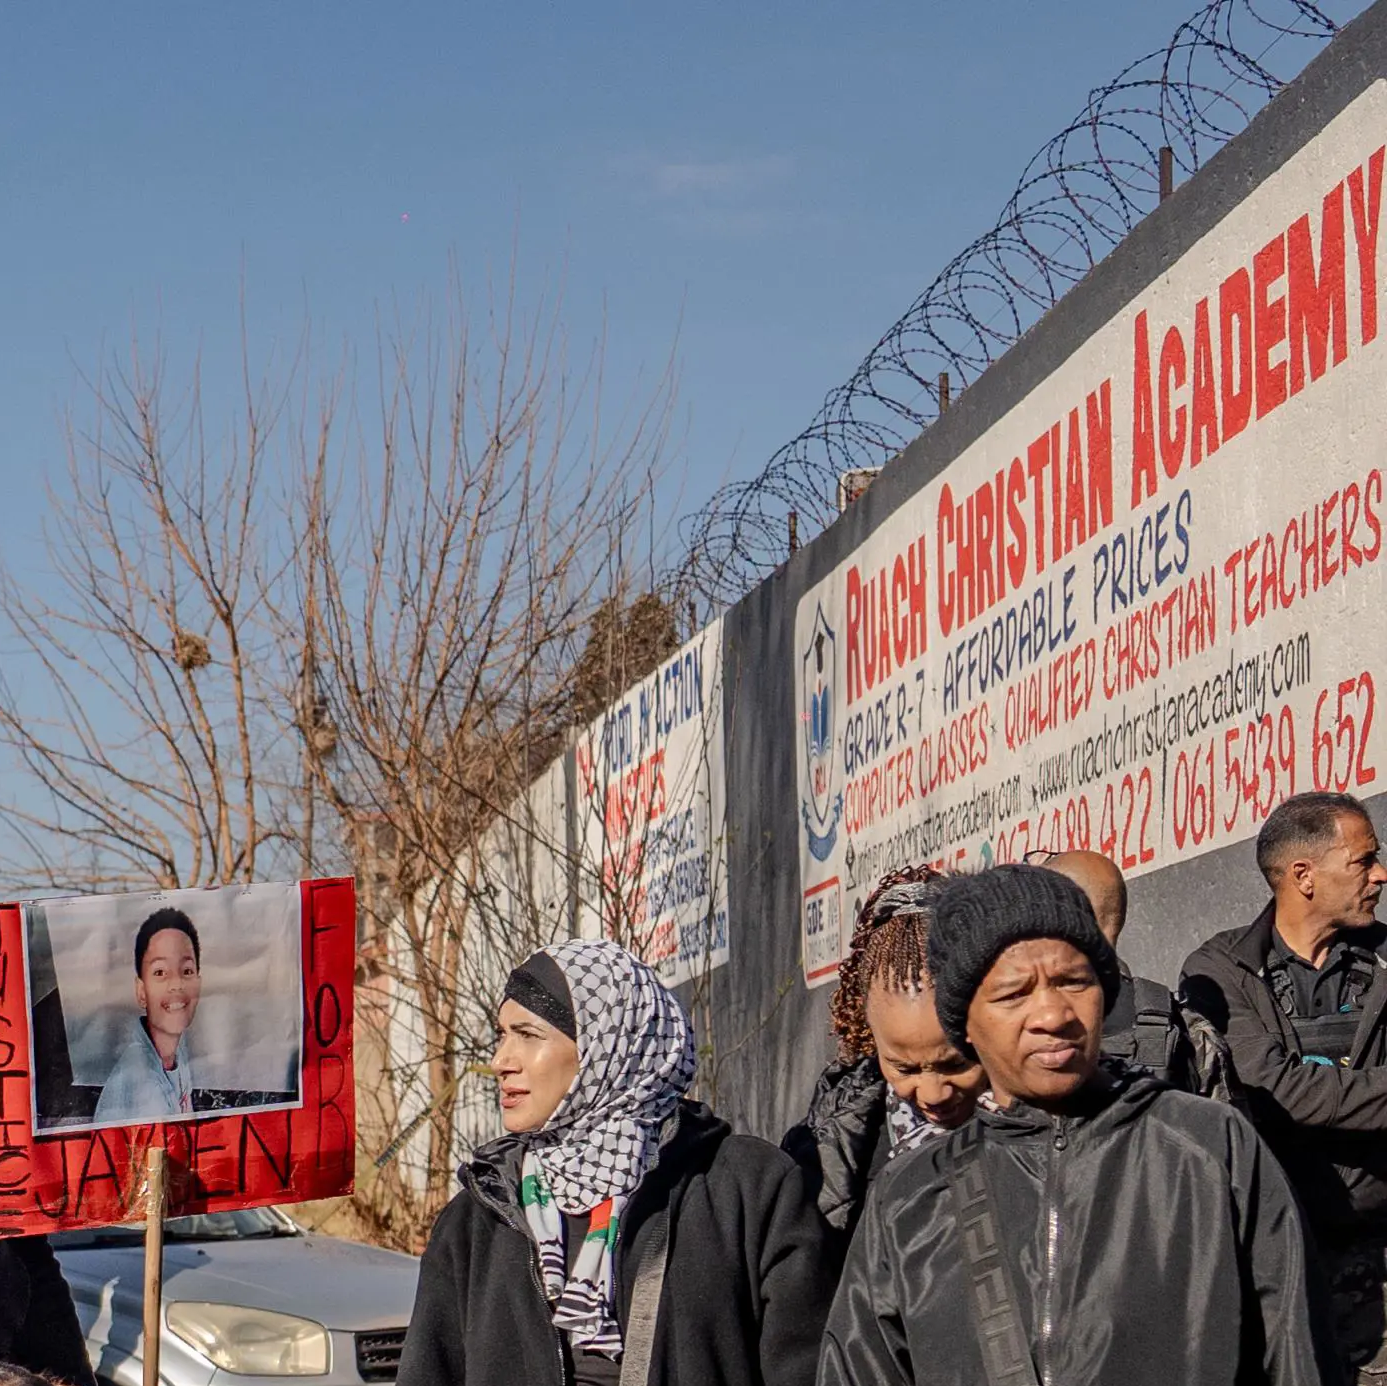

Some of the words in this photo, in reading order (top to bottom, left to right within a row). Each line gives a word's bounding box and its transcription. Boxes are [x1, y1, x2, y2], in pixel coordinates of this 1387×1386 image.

[846, 535, 928, 706] RUACH
[937, 378, 1114, 639] CHRISTIAN
[1130, 144, 1386, 511] ACADEMY
[844, 692, 894, 779] GRADE
[944, 566, 1077, 716] AFFORDABLE
[1093, 488, 1192, 625] PRICES
[844, 747, 914, 834] COMPUTER
[919, 701, 989, 798] CLASSES
[1005, 638, 1096, 751] QUALIFIED
[1103, 565, 1216, 700] CHRISTIAN
[1224, 469, 1383, 635] TEACHERS
[1100, 766, 1155, 870] 422
[1173, 737, 1214, 850] 061
[1224, 705, 1296, 833] 5439
[1312, 671, 1376, 793] 652
[310, 883, 350, 1170] FOR
